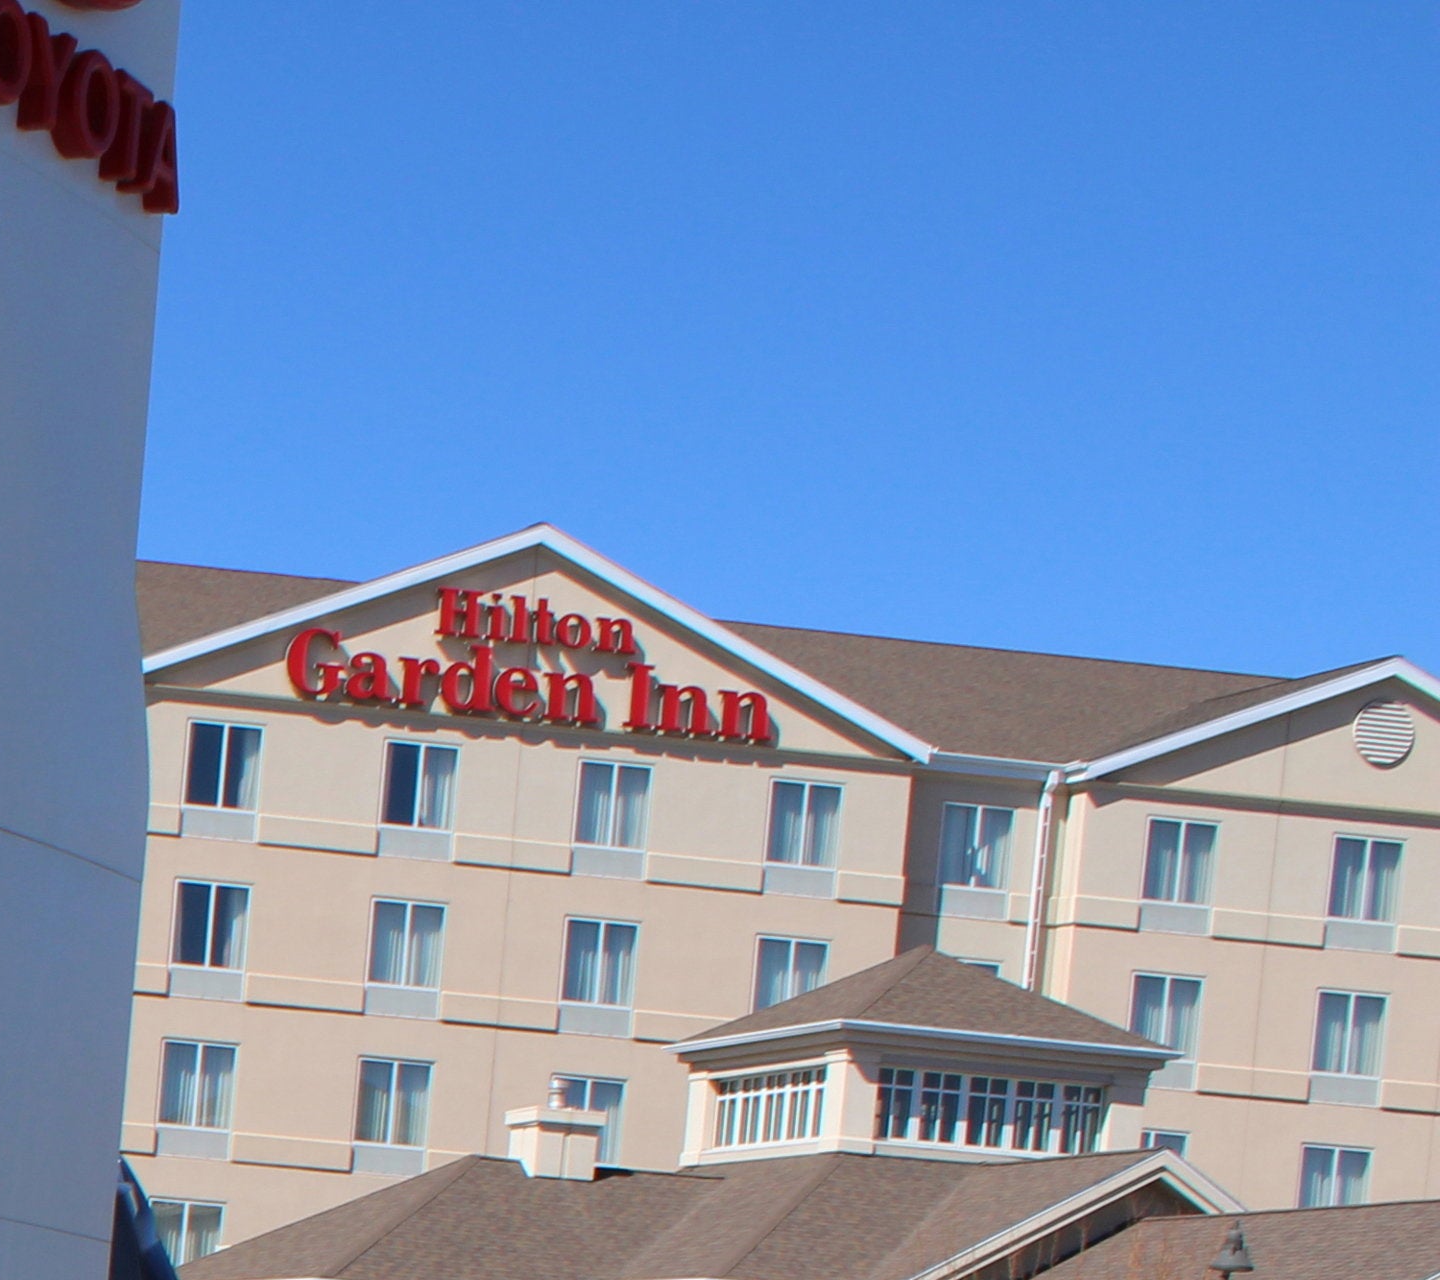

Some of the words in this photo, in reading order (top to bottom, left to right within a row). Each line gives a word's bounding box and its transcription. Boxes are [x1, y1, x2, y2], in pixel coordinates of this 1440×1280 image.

[435, 585, 637, 656] Hilton
[284, 626, 599, 726] Garden
[622, 660, 774, 743] Inn
